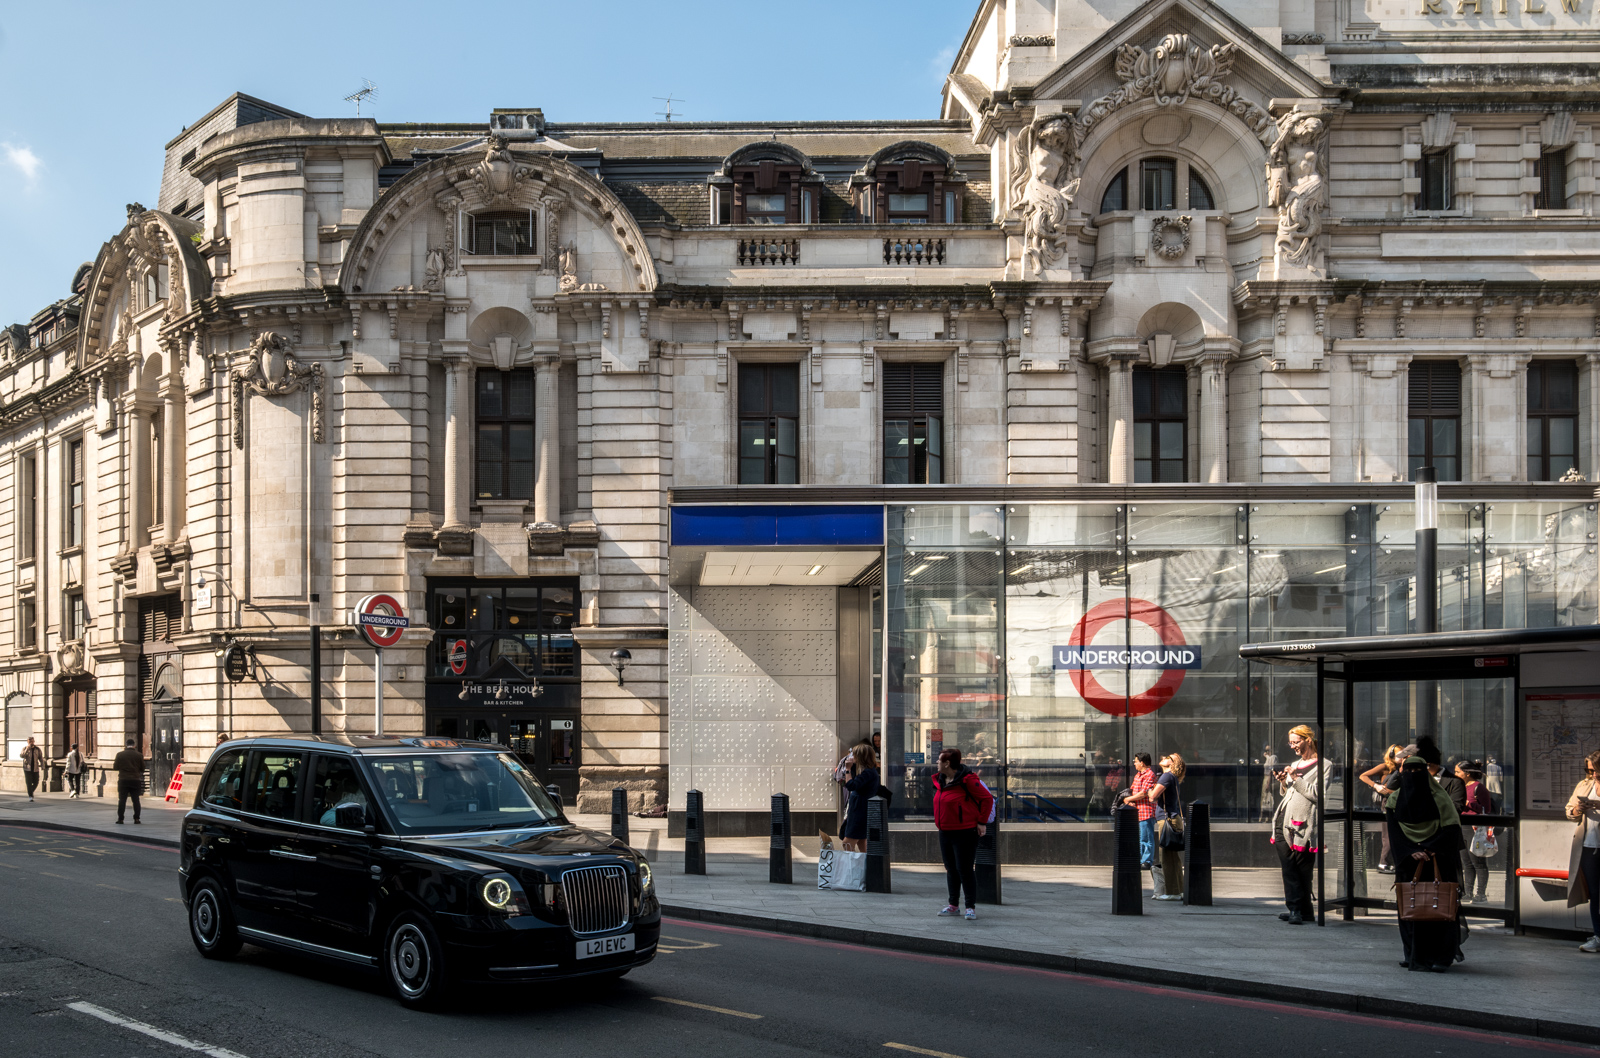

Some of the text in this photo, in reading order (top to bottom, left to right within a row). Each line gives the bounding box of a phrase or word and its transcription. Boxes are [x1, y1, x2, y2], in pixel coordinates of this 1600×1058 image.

[1420, 0, 1600, 14] RAILW
[361, 615, 407, 626] UNDERGROUND
[1059, 650, 1195, 665] UNDERGROUND
[463, 685, 483, 694] THE
[512, 685, 544, 694] HOUE
[425, 739, 457, 748] TAXI
[819, 850, 834, 890] M&S
[586, 937, 627, 956] L21 EVC
